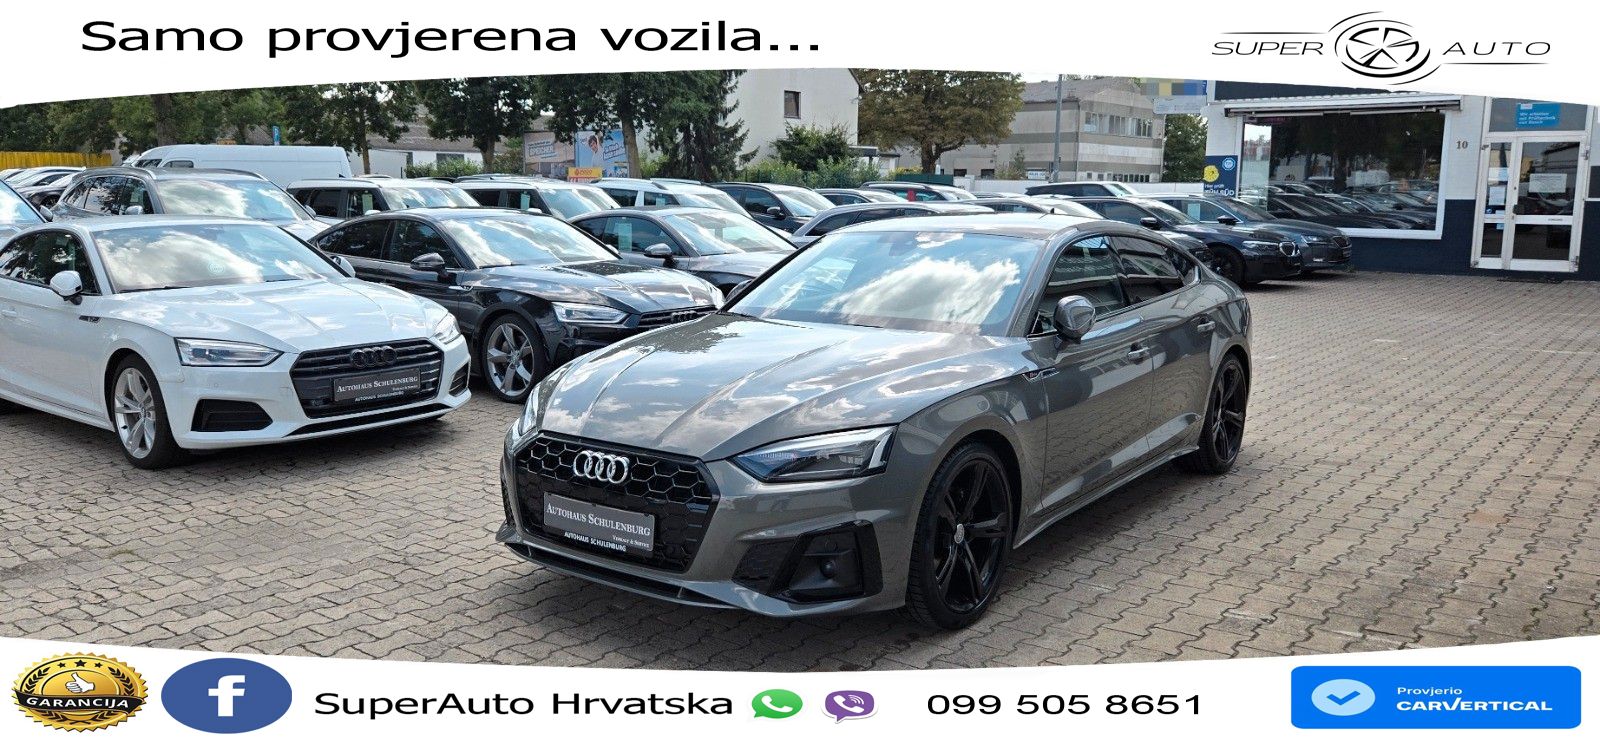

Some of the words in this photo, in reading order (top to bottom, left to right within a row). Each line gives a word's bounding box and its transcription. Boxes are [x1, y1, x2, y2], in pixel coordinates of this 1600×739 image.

[1456, 140, 1469, 149] 10
[546, 502, 587, 522] AUTOHAUS
[588, 513, 651, 536] SCHULENBURG
[564, 531, 589, 543] AUTOHAUS
[590, 537, 627, 552] SCHULENBURG
